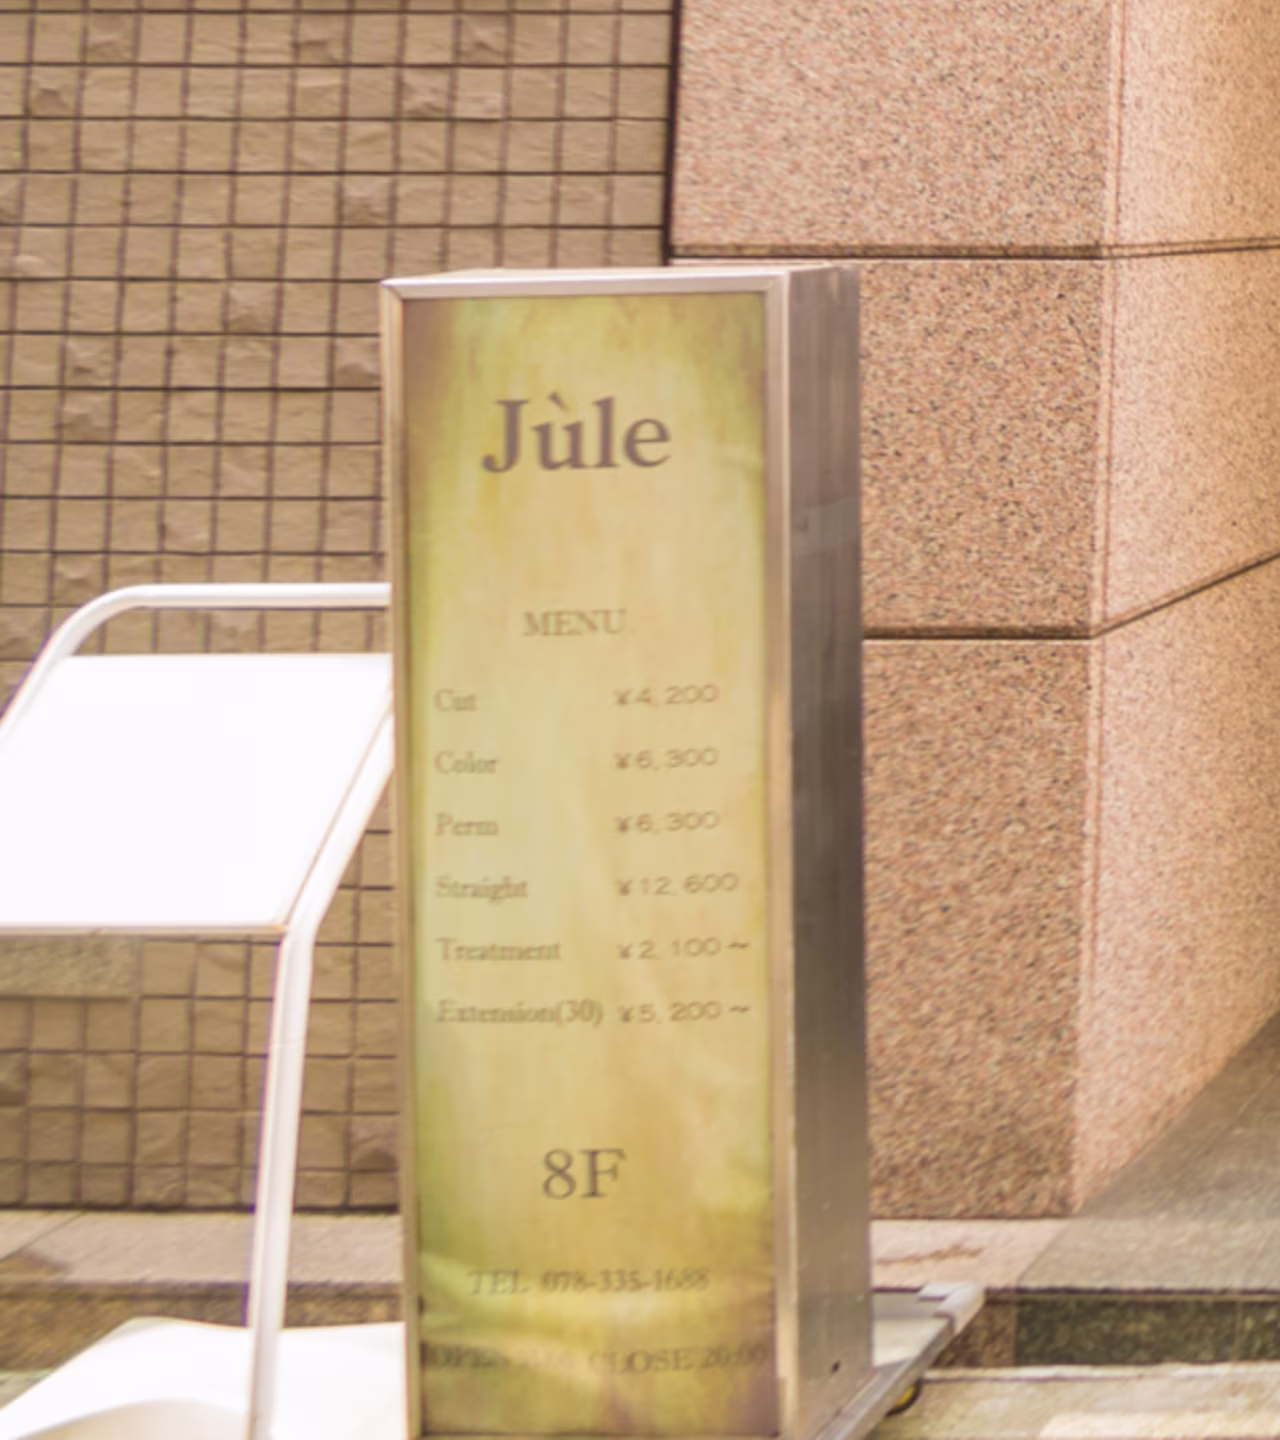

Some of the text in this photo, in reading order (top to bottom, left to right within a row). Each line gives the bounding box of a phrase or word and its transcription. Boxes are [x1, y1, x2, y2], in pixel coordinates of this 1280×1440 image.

[482, 391, 672, 473] Jùle
[522, 609, 627, 637] MENU
[435, 684, 719, 713] Cut ¥4,200
[435, 752, 498, 775] Color
[435, 813, 499, 836] Perm
[435, 876, 528, 904] Straight
[437, 937, 561, 961] Treatment
[542, 1148, 627, 1200] 8F
